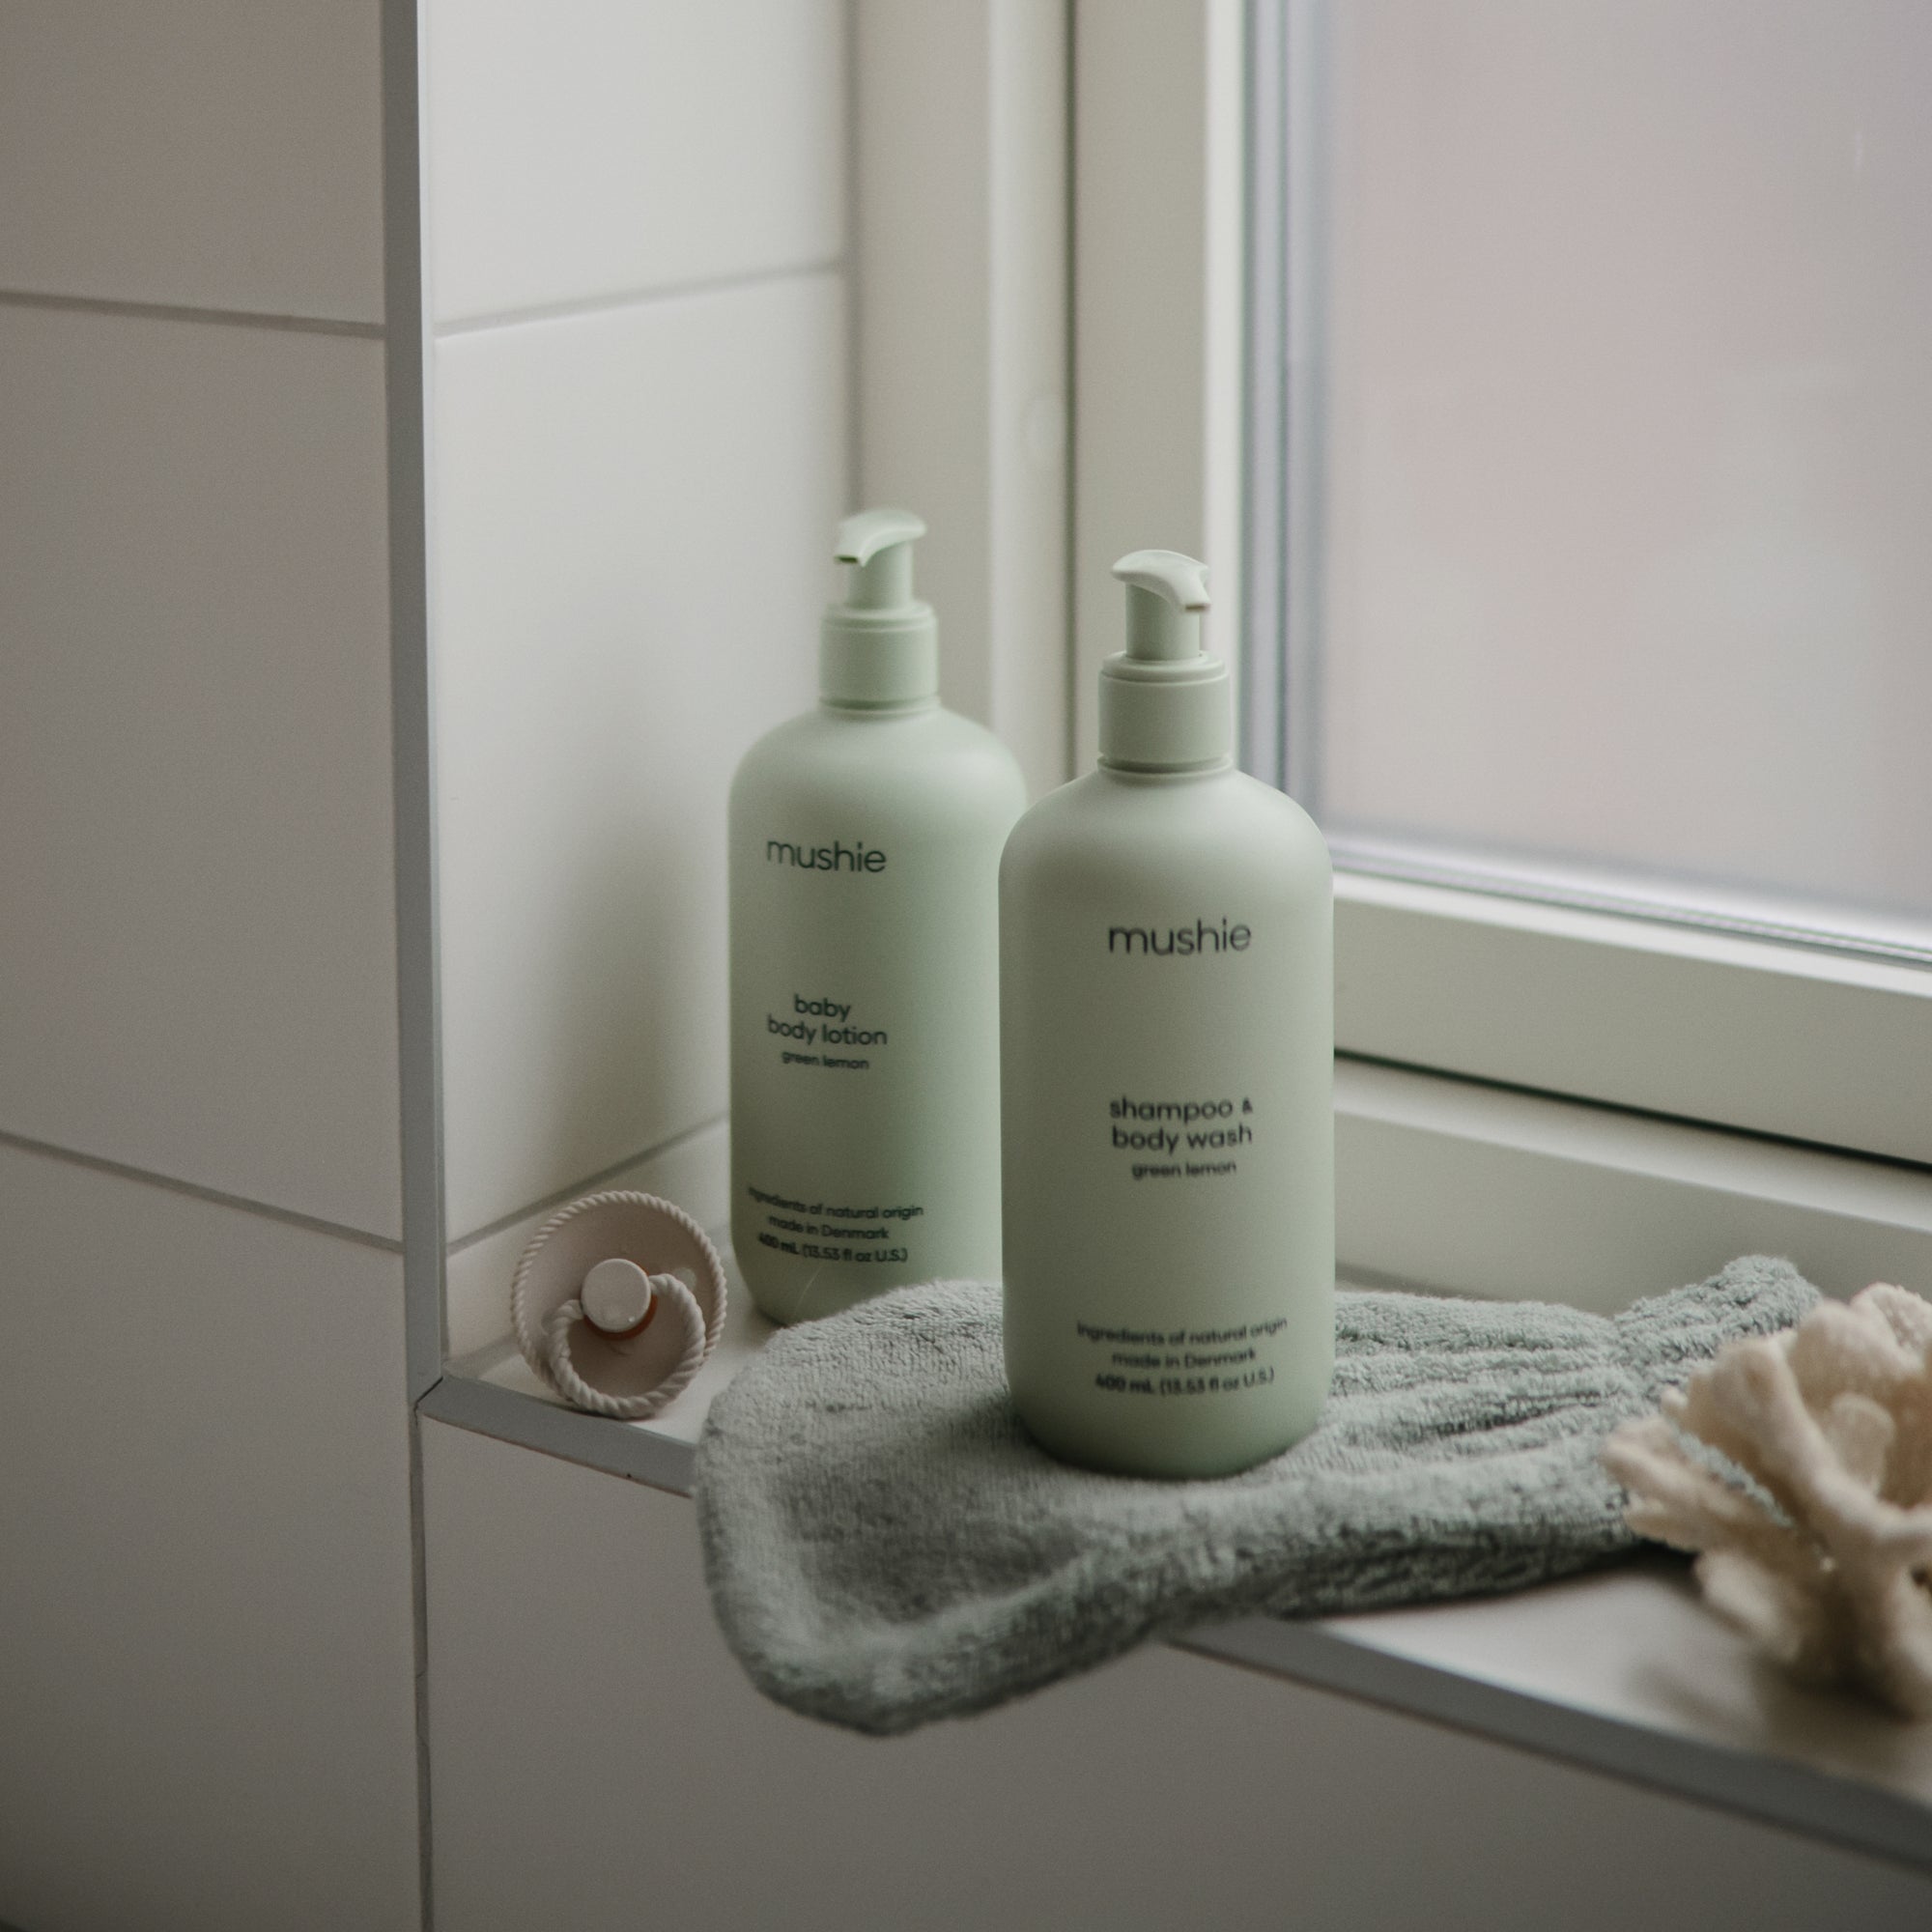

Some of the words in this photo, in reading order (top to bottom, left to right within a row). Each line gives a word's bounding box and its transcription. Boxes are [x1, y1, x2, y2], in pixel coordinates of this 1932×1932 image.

[766, 840, 887, 873] mushie
[1109, 918, 1252, 955] mushie
[794, 994, 851, 1023] baby
[767, 1015, 816, 1045] body
[822, 1024, 888, 1046] lotion
[781, 1051, 819, 1065] green
[822, 1054, 869, 1069] lemon
[1110, 1095, 1234, 1123] shampoo
[1112, 1124, 1179, 1156] body
[1186, 1123, 1253, 1150] wash
[1131, 1162, 1181, 1181] green
[1186, 1160, 1236, 1179] lemon
[810, 1203, 824, 1215] of
[827, 1206, 879, 1219] natural
[882, 1205, 923, 1221] origin
[768, 1215, 805, 1234] made
[807, 1223, 819, 1235] in
[822, 1224, 889, 1240] Denmark
[842, 1247, 854, 1262] fl
[855, 1252, 872, 1263] oz
[874, 1247, 908, 1264] U.S.)
[1077, 1321, 1165, 1346] Ingredients
[1168, 1329, 1185, 1346] of
[1189, 1324, 1247, 1344] natural
[1250, 1317, 1288, 1337] origin
[1112, 1352, 1161, 1368] made
[1165, 1354, 1180, 1368] in
[1184, 1347, 1255, 1369] Denmark
[1209, 1374, 1220, 1392] fl
